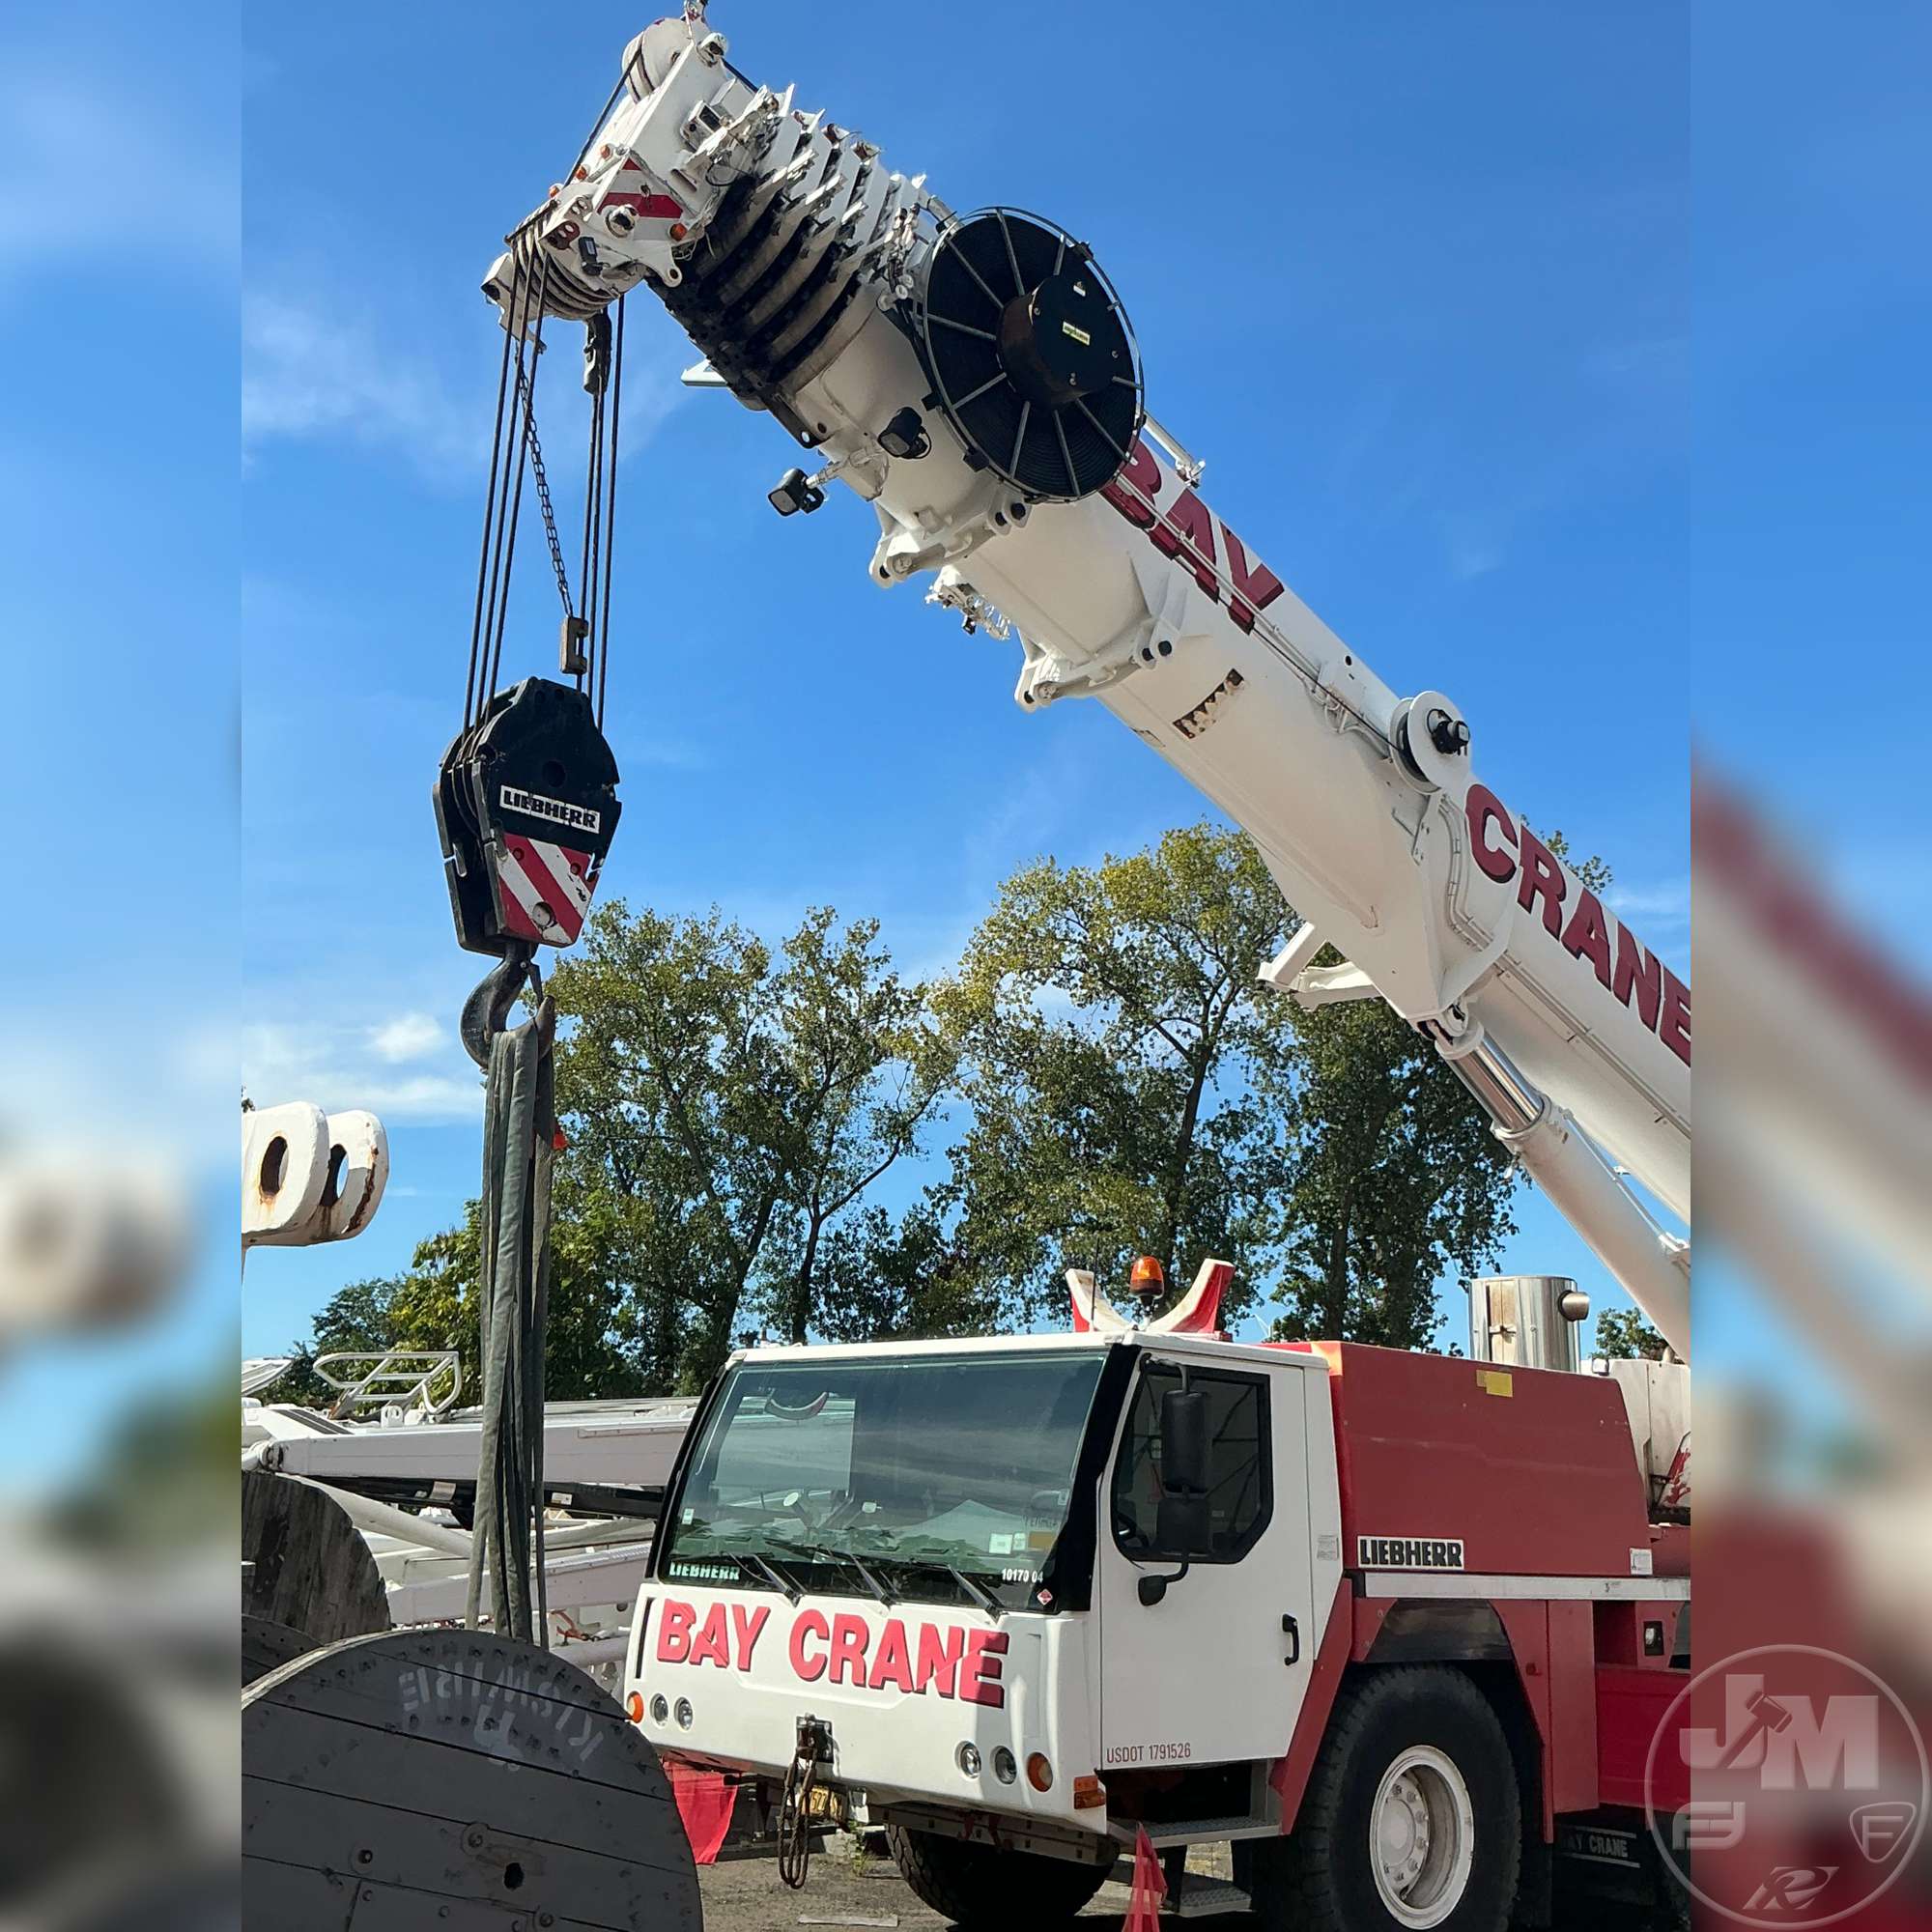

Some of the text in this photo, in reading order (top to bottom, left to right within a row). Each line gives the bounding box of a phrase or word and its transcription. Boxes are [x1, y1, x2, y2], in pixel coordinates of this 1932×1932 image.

[503, 790, 596, 829] LIEBHERR
[1464, 783, 1690, 1068] CRANE
[1360, 1539, 1463, 1567] LIEBHERR
[668, 1561, 740, 1580] LIEBHERR
[1002, 1566, 1030, 1582] 10170
[657, 1598, 1009, 1709] BAY CRANE
[1106, 1742, 1191, 1763] USDOT 1791526
[1589, 1835, 1629, 1858] CRANE
